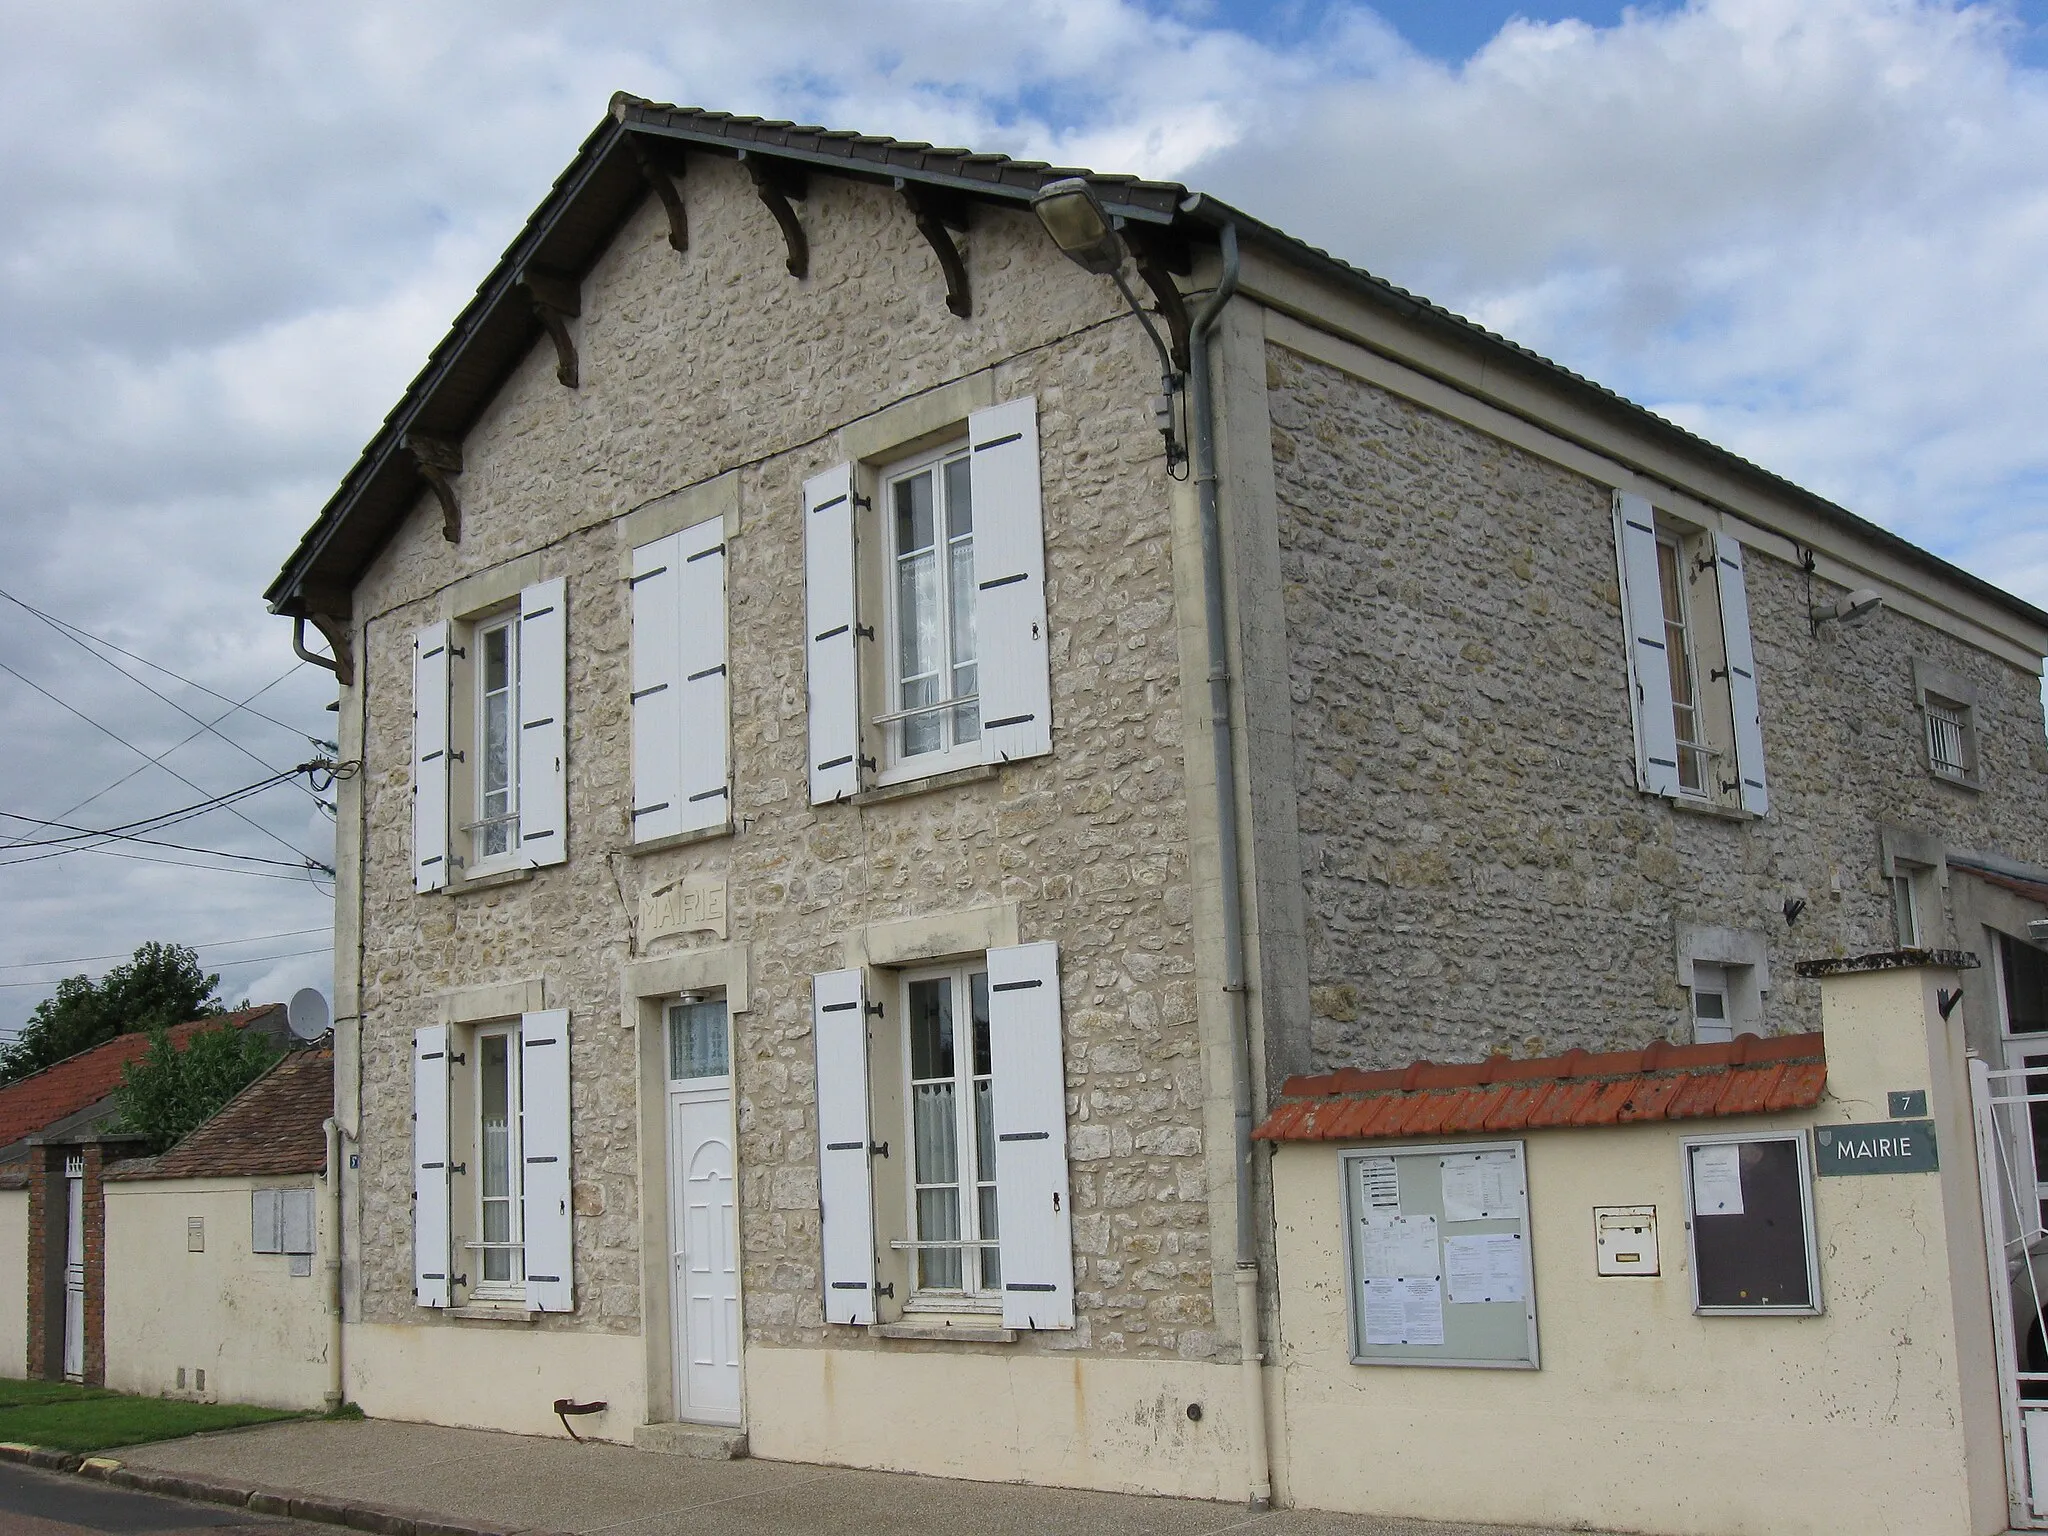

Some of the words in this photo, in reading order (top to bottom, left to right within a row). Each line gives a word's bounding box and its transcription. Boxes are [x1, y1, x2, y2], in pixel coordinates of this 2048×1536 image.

[641, 886, 724, 930] MAIRIE
[1902, 1097, 1911, 1110] 7
[1838, 1138, 1911, 1160] MAIRIE
